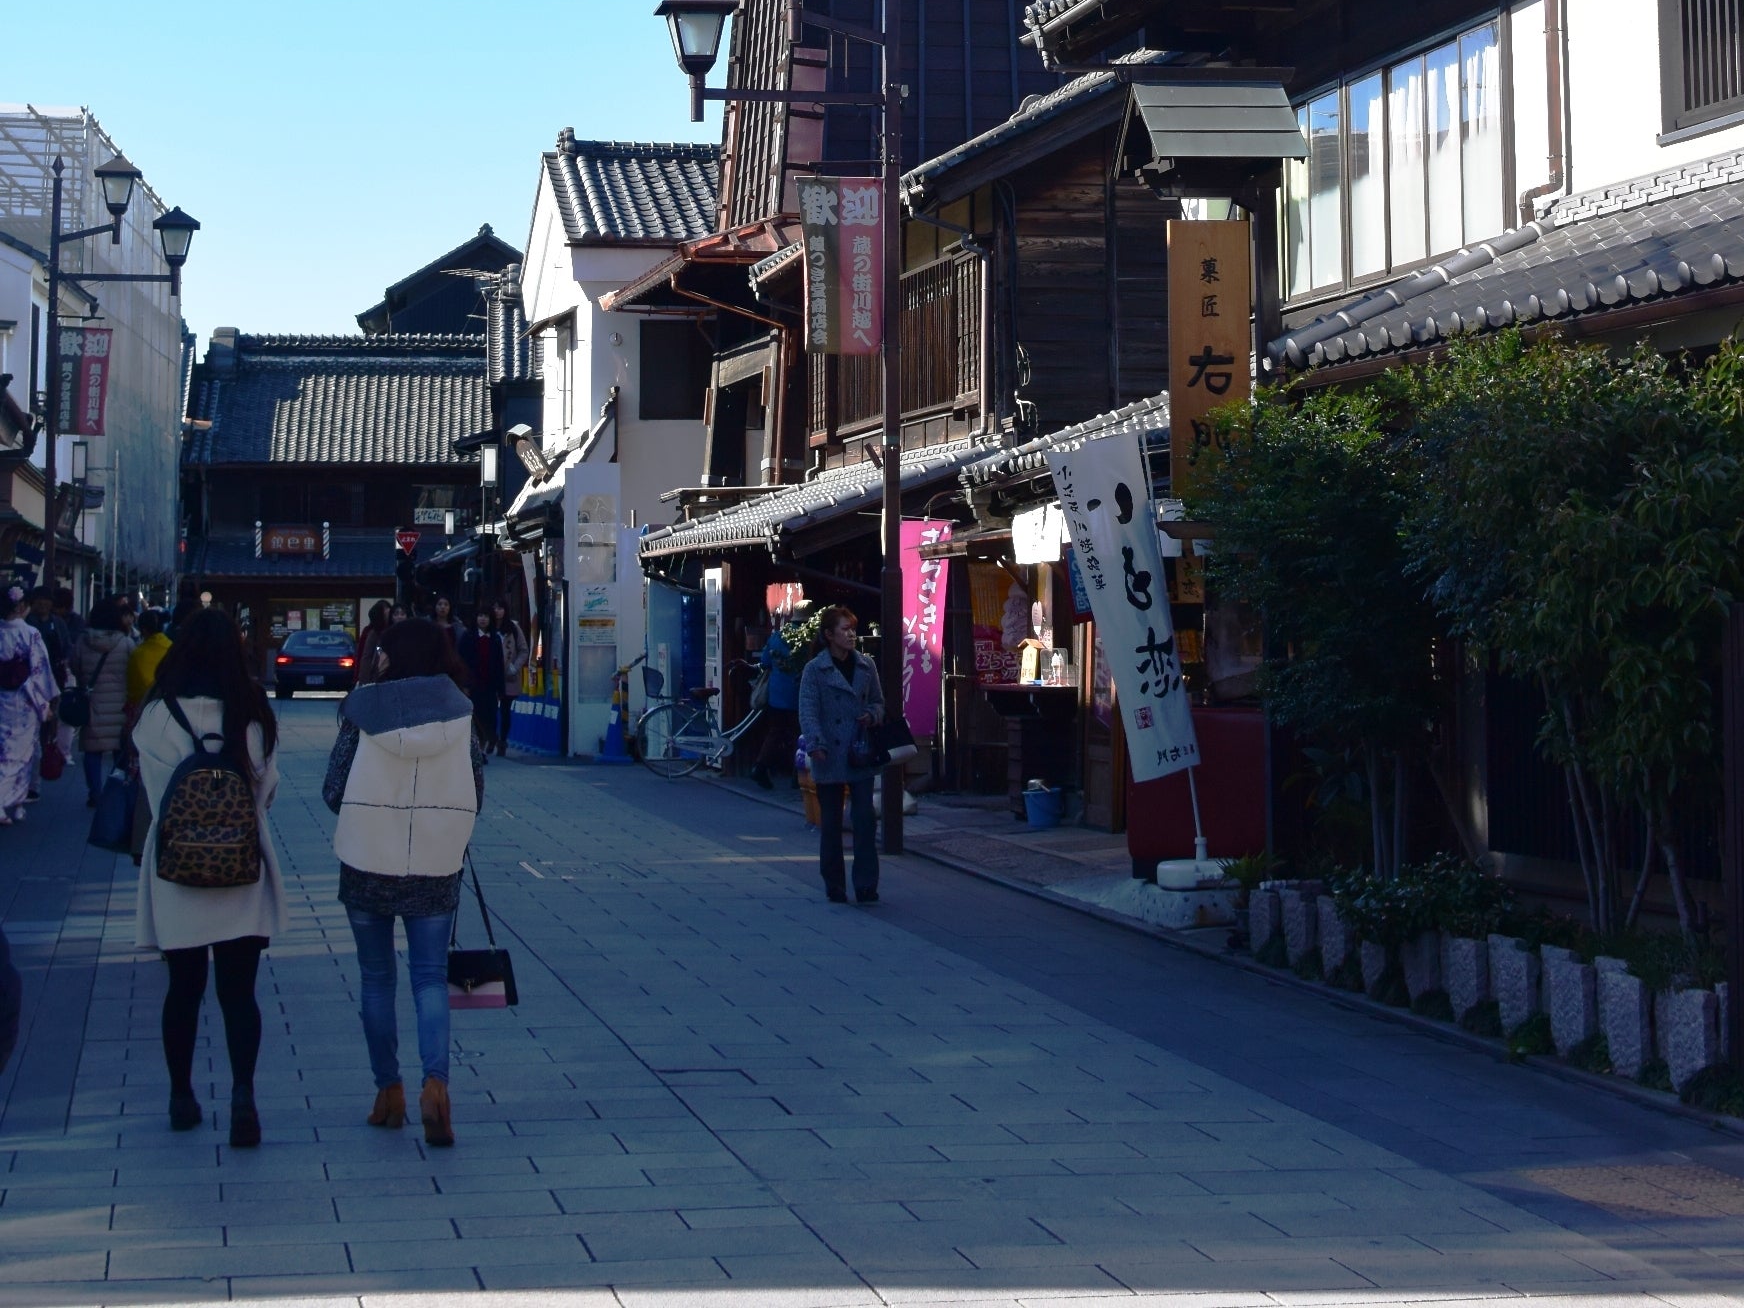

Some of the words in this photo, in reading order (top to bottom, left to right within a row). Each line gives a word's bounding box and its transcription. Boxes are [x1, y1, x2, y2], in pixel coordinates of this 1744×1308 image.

[801, 184, 880, 226] 歓迎
[852, 235, 872, 347] 蔵の街川越へ
[1200, 257, 1220, 318] 菓匠
[59, 331, 110, 358] 歓迎
